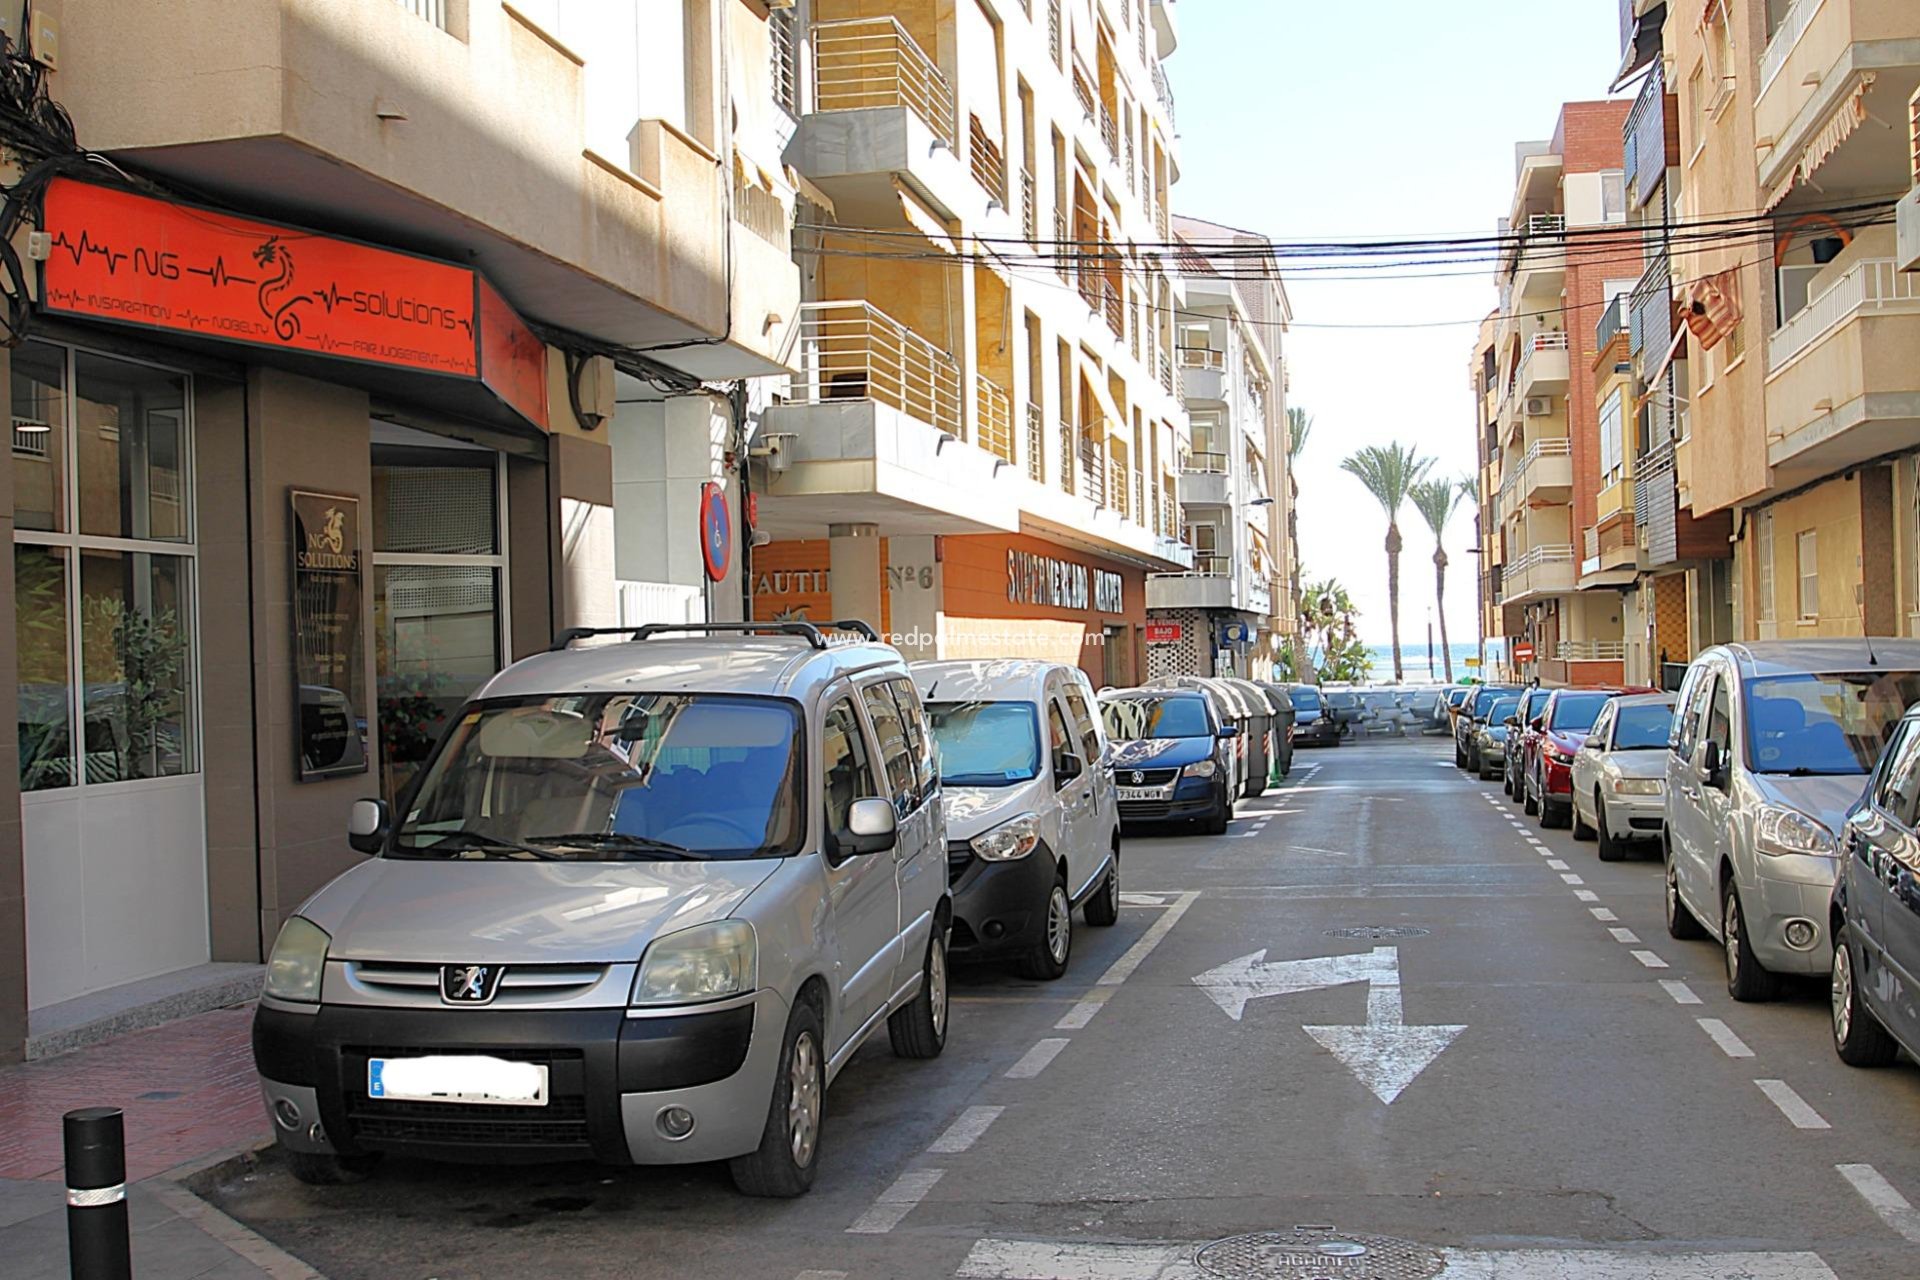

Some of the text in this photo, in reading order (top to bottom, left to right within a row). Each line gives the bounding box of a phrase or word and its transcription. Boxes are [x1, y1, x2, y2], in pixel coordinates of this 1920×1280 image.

[133, 247, 456, 330] NG solutions
[87, 294, 440, 364] INSPIRATION NOBELTY FAIR JUDGEMENT
[308, 532, 325, 549] NG
[298, 551, 357, 570] SOLUTIONS
[918, 565, 934, 590] 6
[1006, 547, 1089, 611] SUPERMERCADO
[1154, 627, 1173, 635] BAJO
[373, 1082, 381, 1091] E
